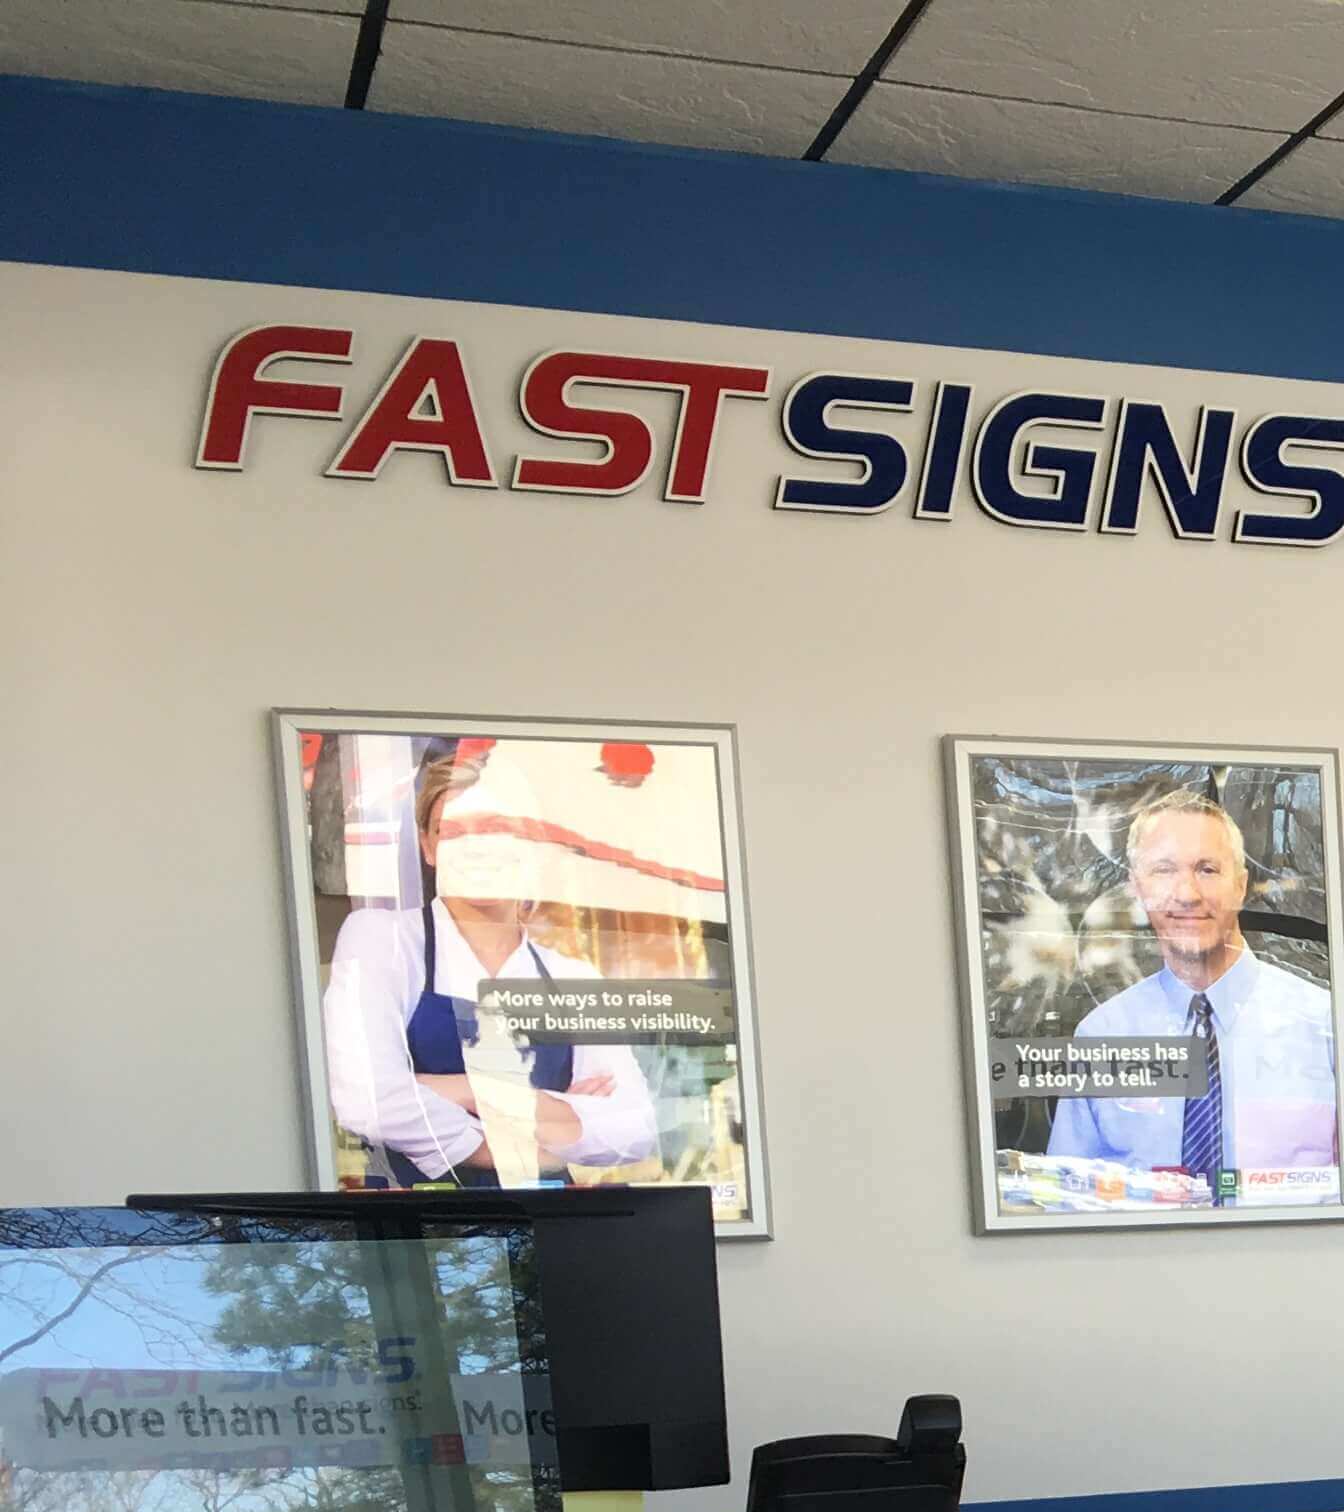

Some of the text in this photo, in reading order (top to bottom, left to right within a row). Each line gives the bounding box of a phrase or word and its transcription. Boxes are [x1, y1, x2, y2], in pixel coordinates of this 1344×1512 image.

[492, 990, 672, 1010] More ways to raise
[495, 1014, 715, 1033] your business visibility.
[1016, 1043, 1187, 1061] Your business has
[1018, 1070, 1156, 1091] a story to tell.
[1248, 1171, 1331, 1184] FASTSIGNS
[40, 1397, 164, 1441] More
[177, 1394, 282, 1437] than
[293, 1396, 387, 1436] fast.
